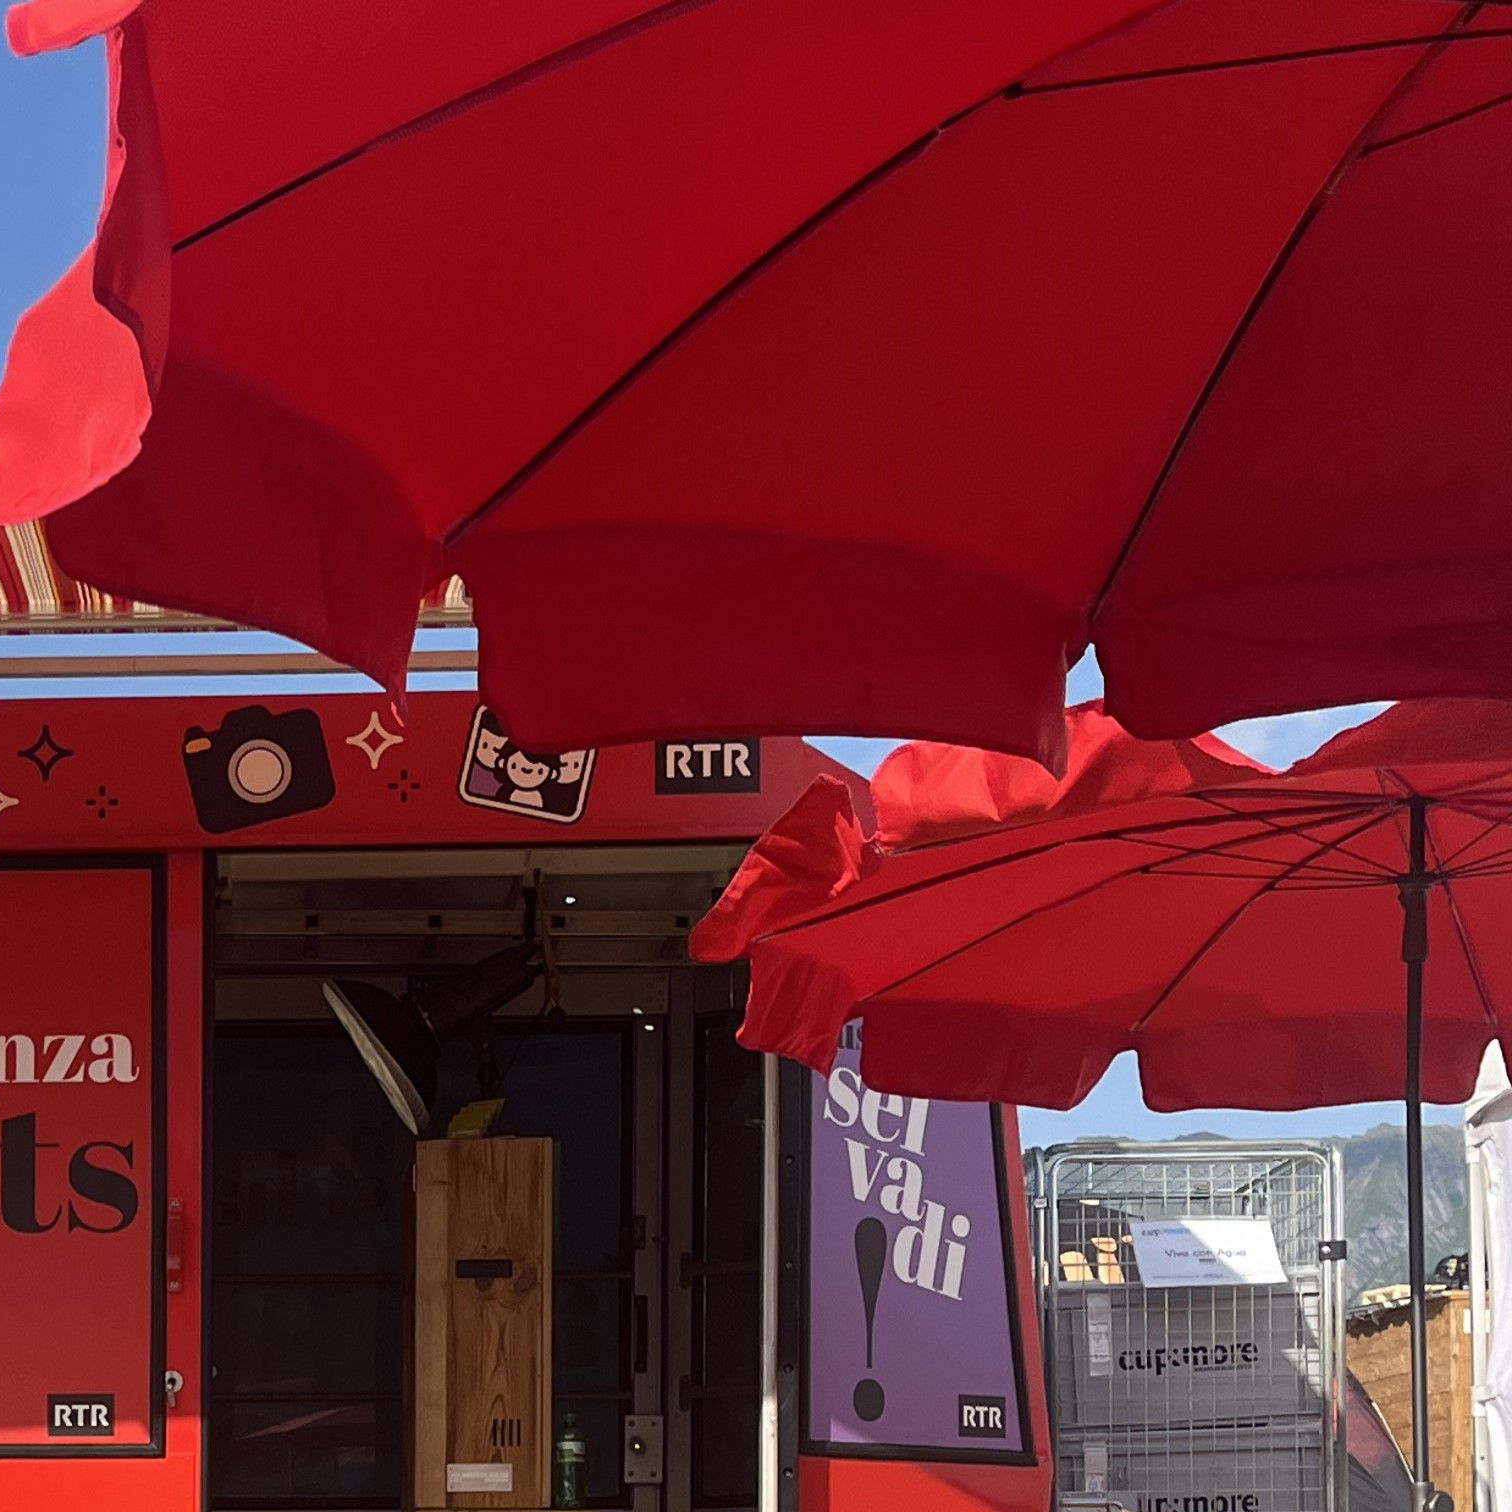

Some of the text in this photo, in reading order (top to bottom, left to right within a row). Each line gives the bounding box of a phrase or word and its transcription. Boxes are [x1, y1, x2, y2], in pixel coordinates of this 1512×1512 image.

[666, 742, 751, 778] RTR
[823, 1066, 929, 1158] sel
[843, 1136, 931, 1222] va
[892, 1199, 971, 1301] di
[53, 1403, 110, 1428] RTR
[962, 1405, 1003, 1430] RTR
